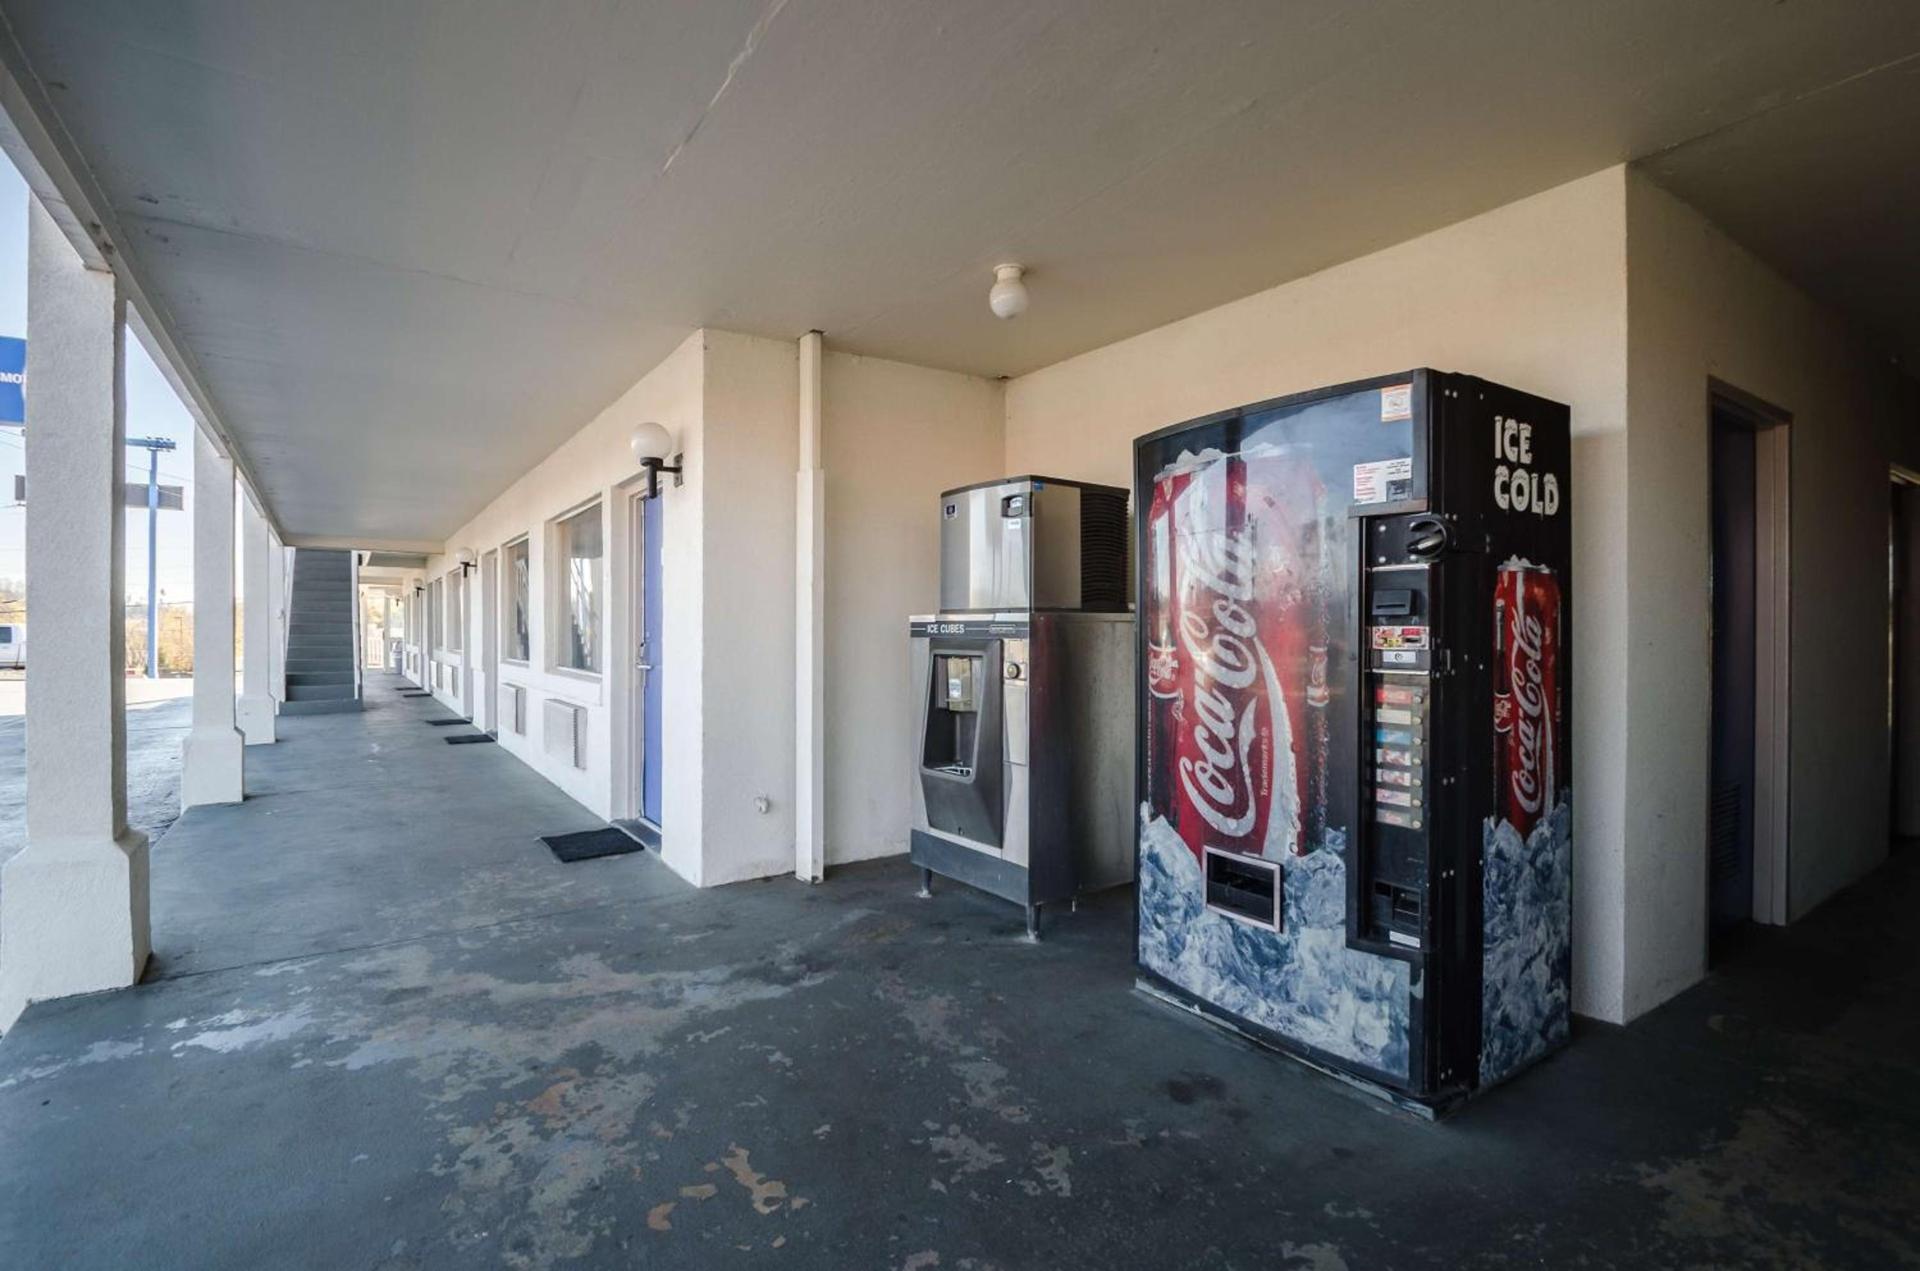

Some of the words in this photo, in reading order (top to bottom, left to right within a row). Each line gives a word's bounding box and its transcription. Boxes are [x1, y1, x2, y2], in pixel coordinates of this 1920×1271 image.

[1494, 415, 1532, 464] ICE
[1494, 465, 1559, 516] COLD
[927, 624, 939, 634] ICE
[940, 624, 965, 634] CUBES
